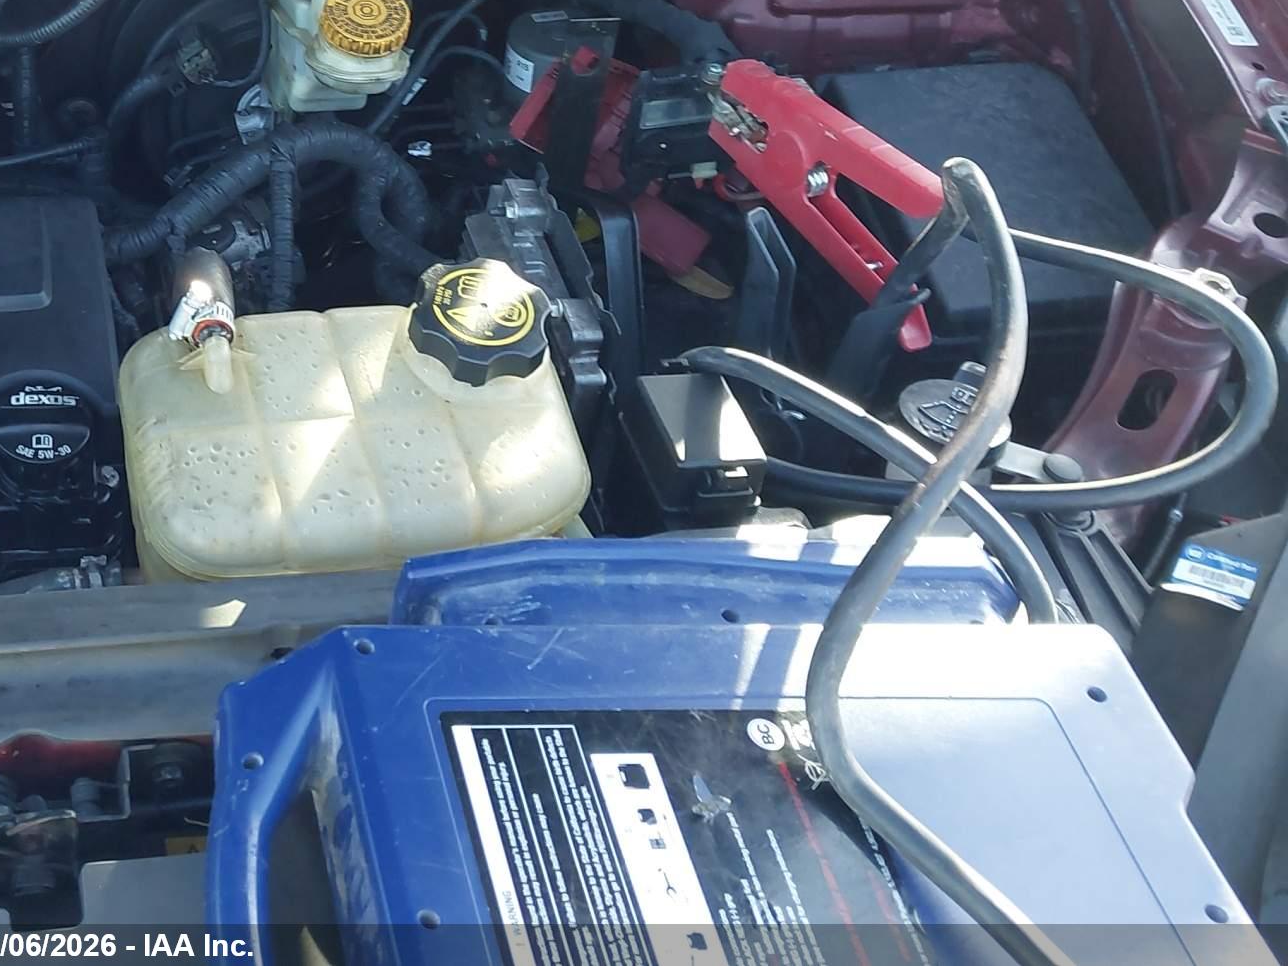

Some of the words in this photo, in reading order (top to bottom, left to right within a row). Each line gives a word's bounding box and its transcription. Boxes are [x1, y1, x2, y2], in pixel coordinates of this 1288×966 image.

[10, 391, 80, 407] dexos
[15, 444, 35, 458] SAE
[37, 444, 72, 459] 5W-30
[501, 889, 522, 936] WARNING
